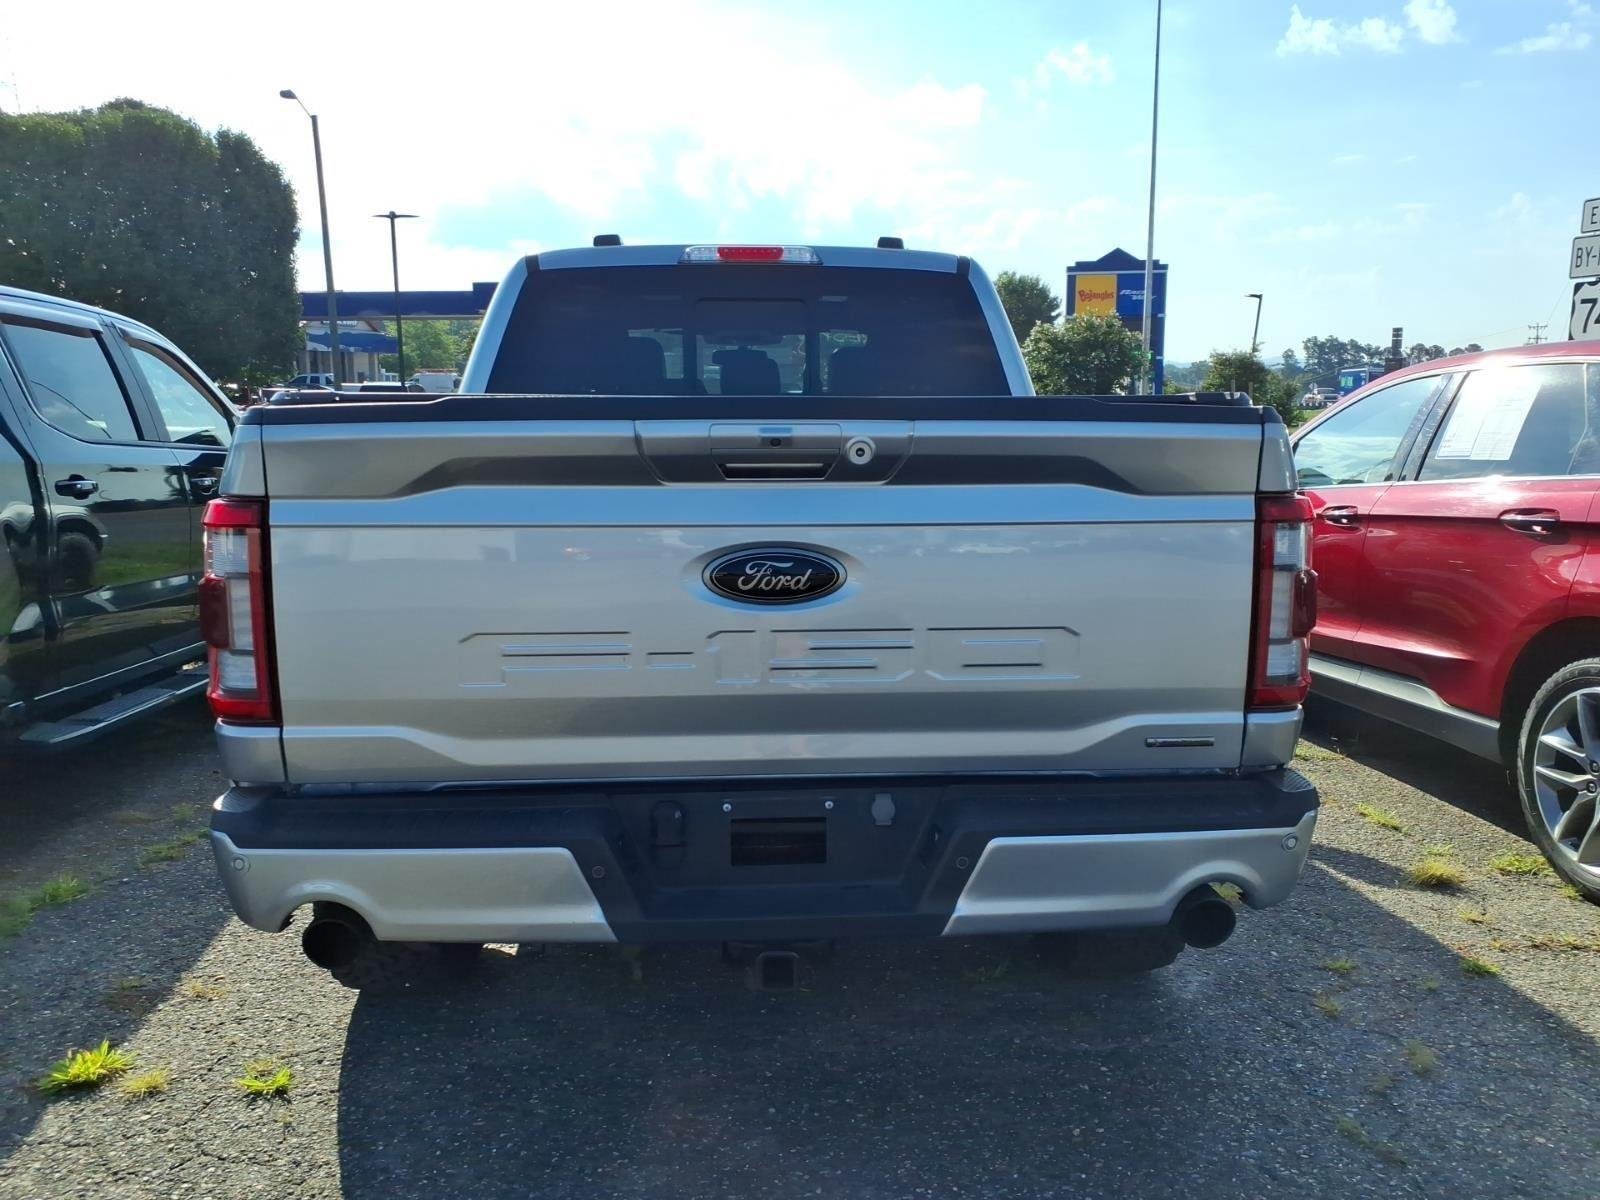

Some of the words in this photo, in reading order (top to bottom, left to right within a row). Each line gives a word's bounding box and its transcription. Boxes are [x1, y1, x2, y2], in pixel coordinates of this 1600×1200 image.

[1590, 206, 1600, 225] E
[1575, 245, 1600, 268] BY-
[737, 560, 812, 591] Ford
[458, 626, 1081, 688] F-150
